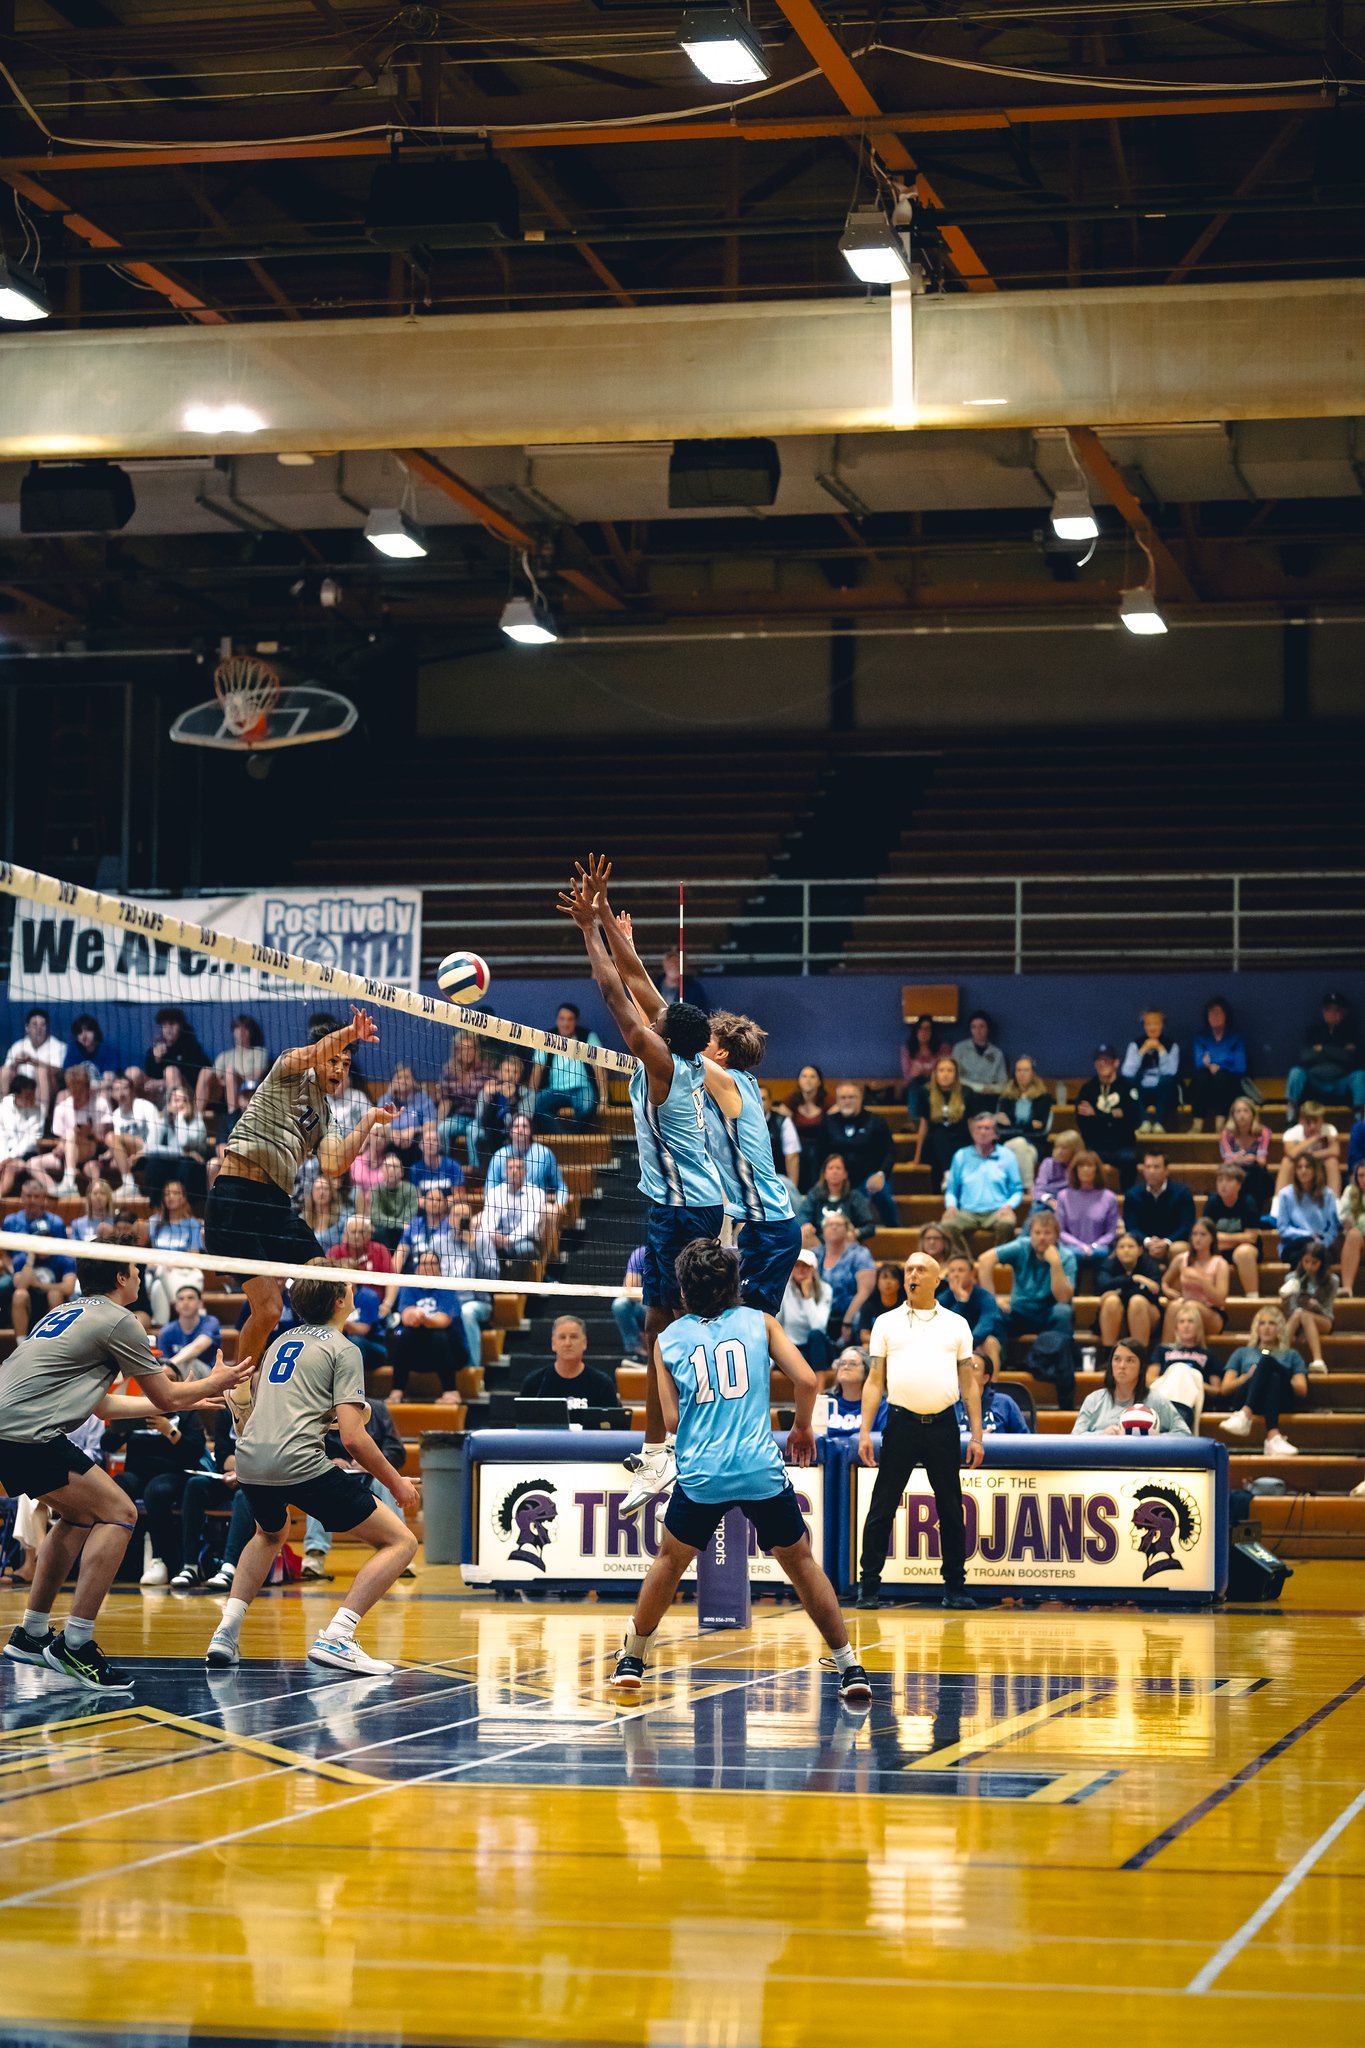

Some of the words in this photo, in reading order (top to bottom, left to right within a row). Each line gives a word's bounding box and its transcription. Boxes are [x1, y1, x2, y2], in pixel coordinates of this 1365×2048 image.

[264, 897, 415, 936] Positively
[22, 919, 105, 975] We
[267, 1339, 306, 1385] 8
[688, 1337, 750, 1405] 10
[961, 1477, 982, 1489] ME
[987, 1477, 1005, 1489] OF
[1010, 1478, 1036, 1490] THE
[713, 1515, 727, 1565] mports
[903, 1567, 941, 1576] DONAT
[973, 1567, 1015, 1578] TROJAN
[1018, 1568, 1076, 1579] BOOSTERS
